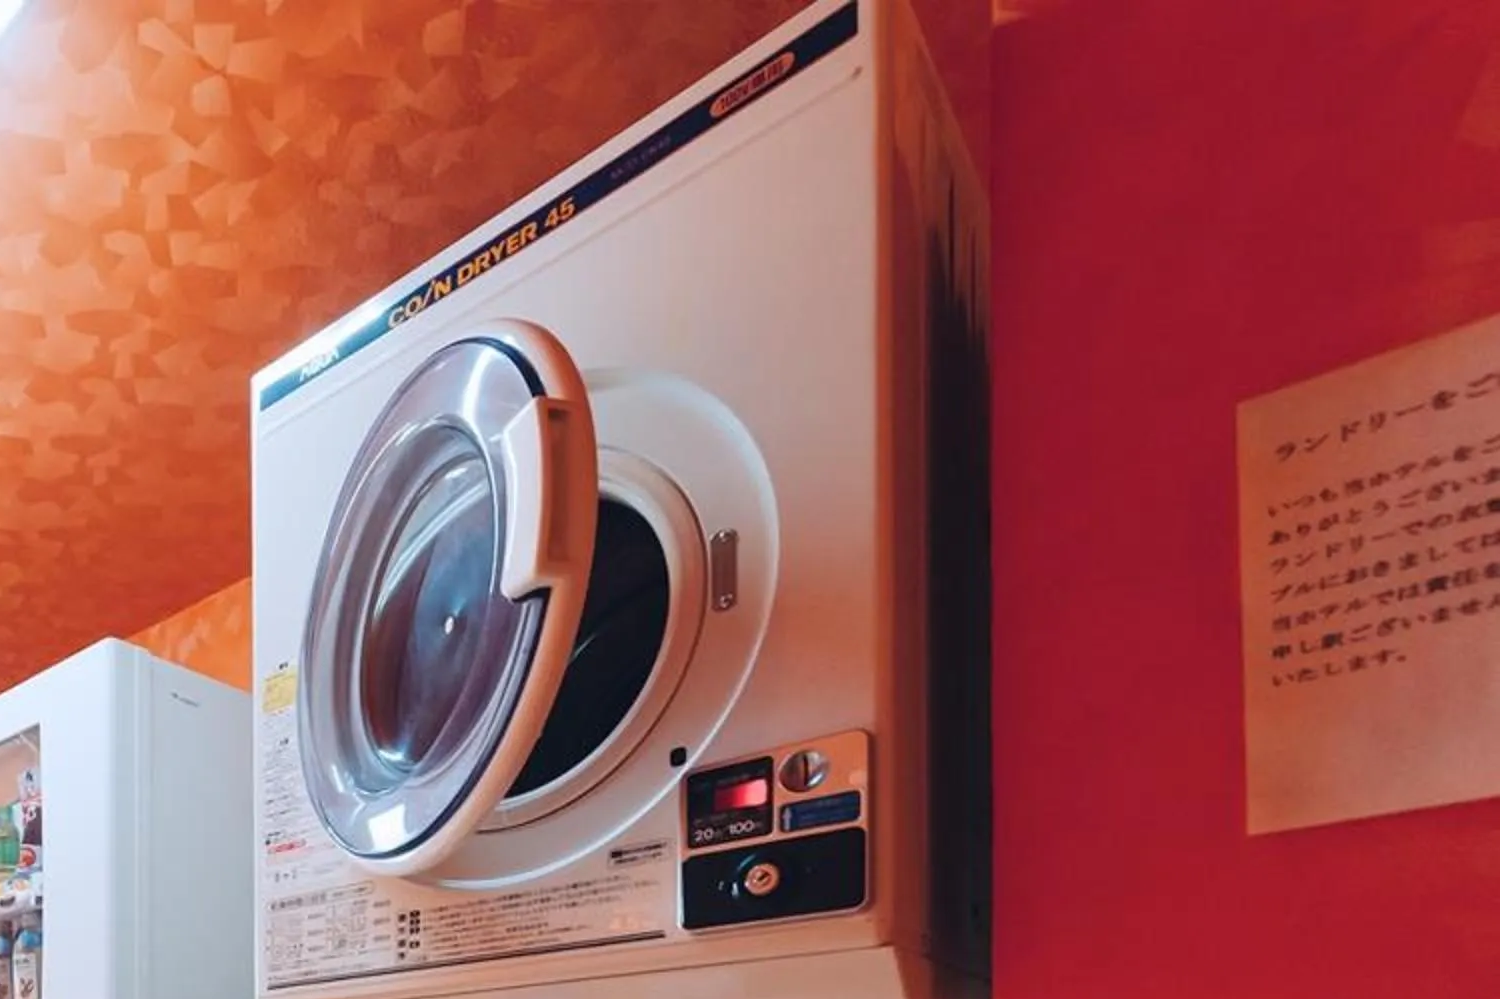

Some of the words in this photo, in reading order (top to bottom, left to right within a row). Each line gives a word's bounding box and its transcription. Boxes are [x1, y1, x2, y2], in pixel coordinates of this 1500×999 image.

[388, 275, 453, 329] COIN
[457, 221, 538, 285] DRYER
[544, 196, 577, 230] 45
